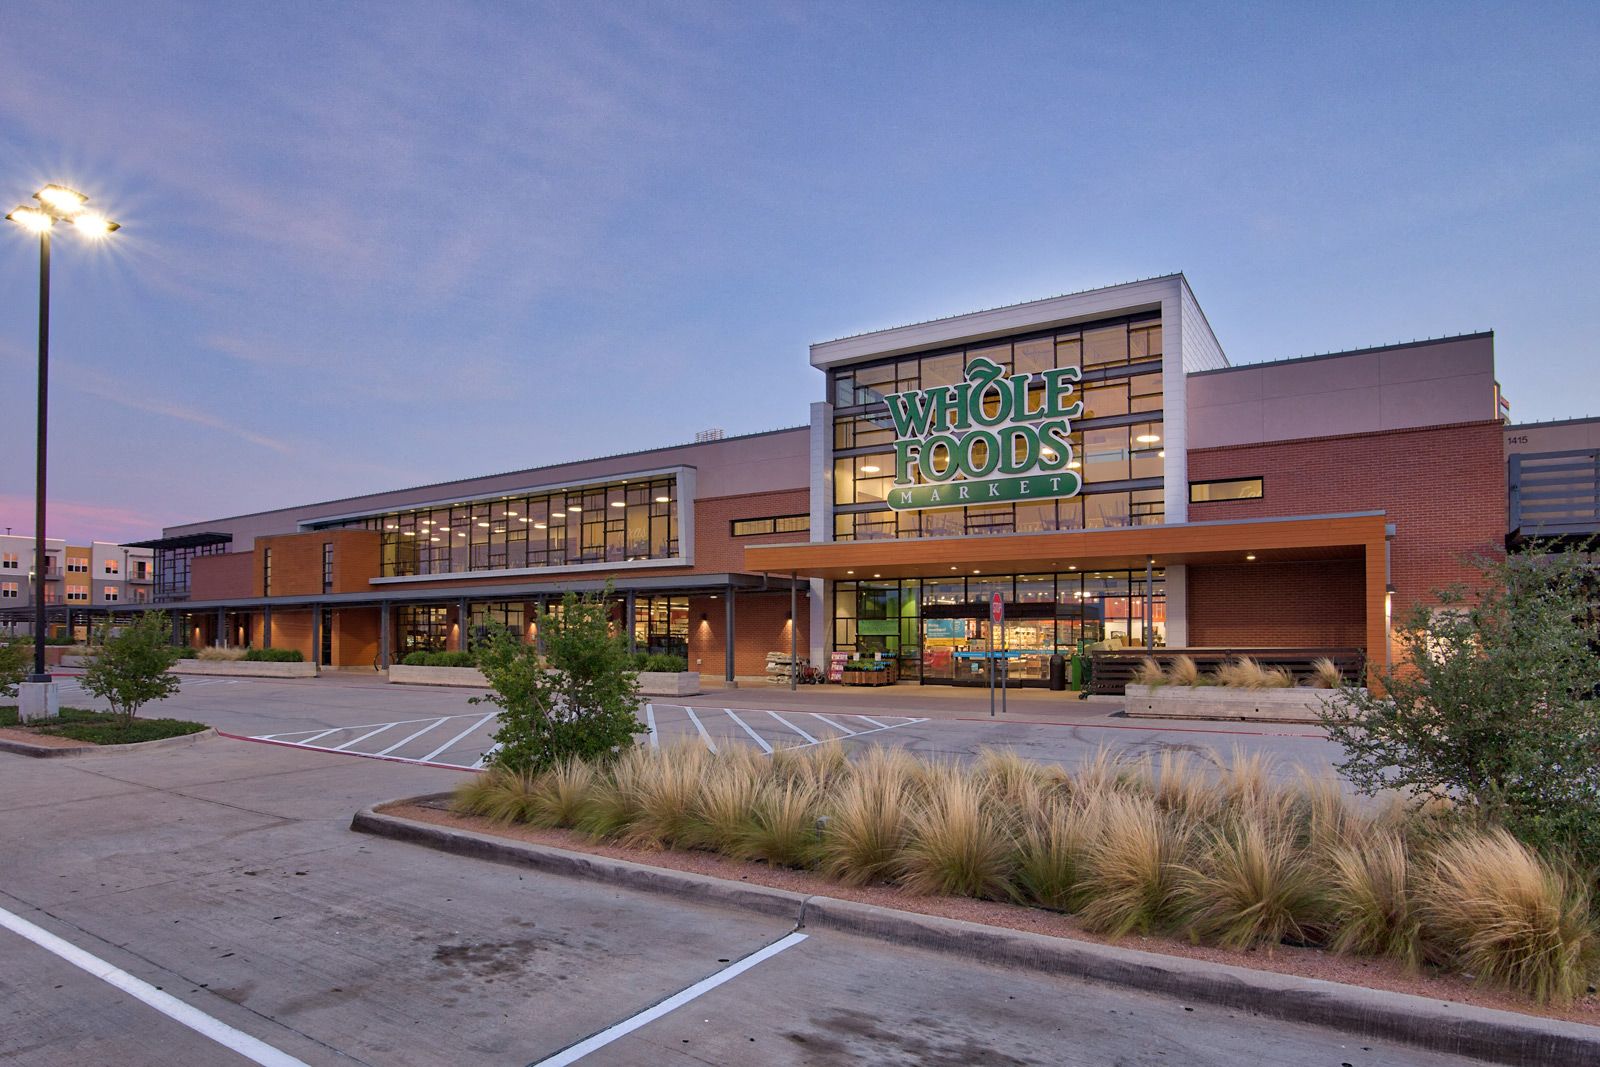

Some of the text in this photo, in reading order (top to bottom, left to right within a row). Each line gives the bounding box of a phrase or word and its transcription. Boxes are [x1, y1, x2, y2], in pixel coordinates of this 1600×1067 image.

[883, 357, 1083, 439] WHOLE
[893, 420, 1072, 485] FOODS
[1507, 435, 1528, 444] 1415
[900, 477, 1062, 505] MARKET
[992, 601, 1002, 613] STOP
